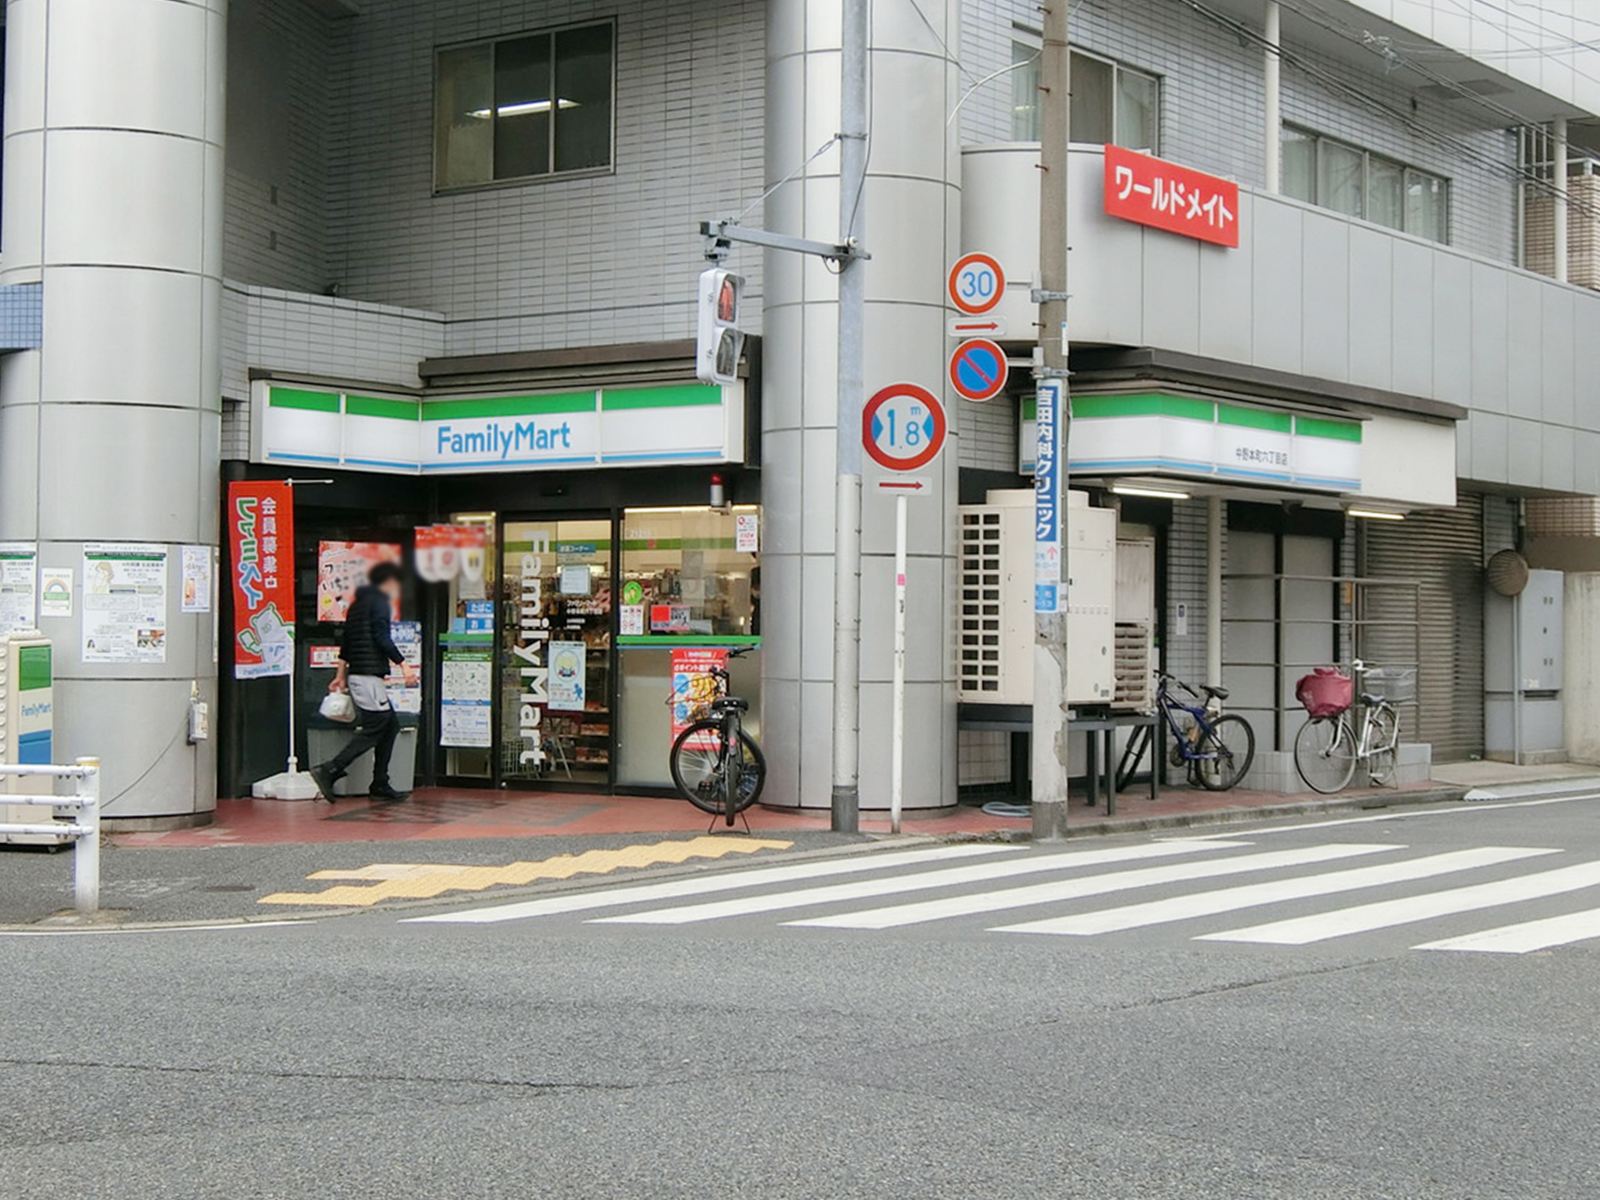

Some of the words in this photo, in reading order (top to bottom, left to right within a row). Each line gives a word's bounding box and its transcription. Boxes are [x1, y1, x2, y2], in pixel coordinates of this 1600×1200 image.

[1115, 165, 1234, 229] ワールドメイト
[961, 270, 993, 298] 30
[910, 405, 921, 416] m
[437, 421, 571, 459] FamilyMart
[1036, 388, 1054, 539] 吉田内科クリニック
[1235, 448, 1288, 466] 中野本町六丁目店
[470, 602, 492, 612] たばこ
[513, 529, 550, 766] FamilyMart
[21, 703, 52, 718] FamilyMart
